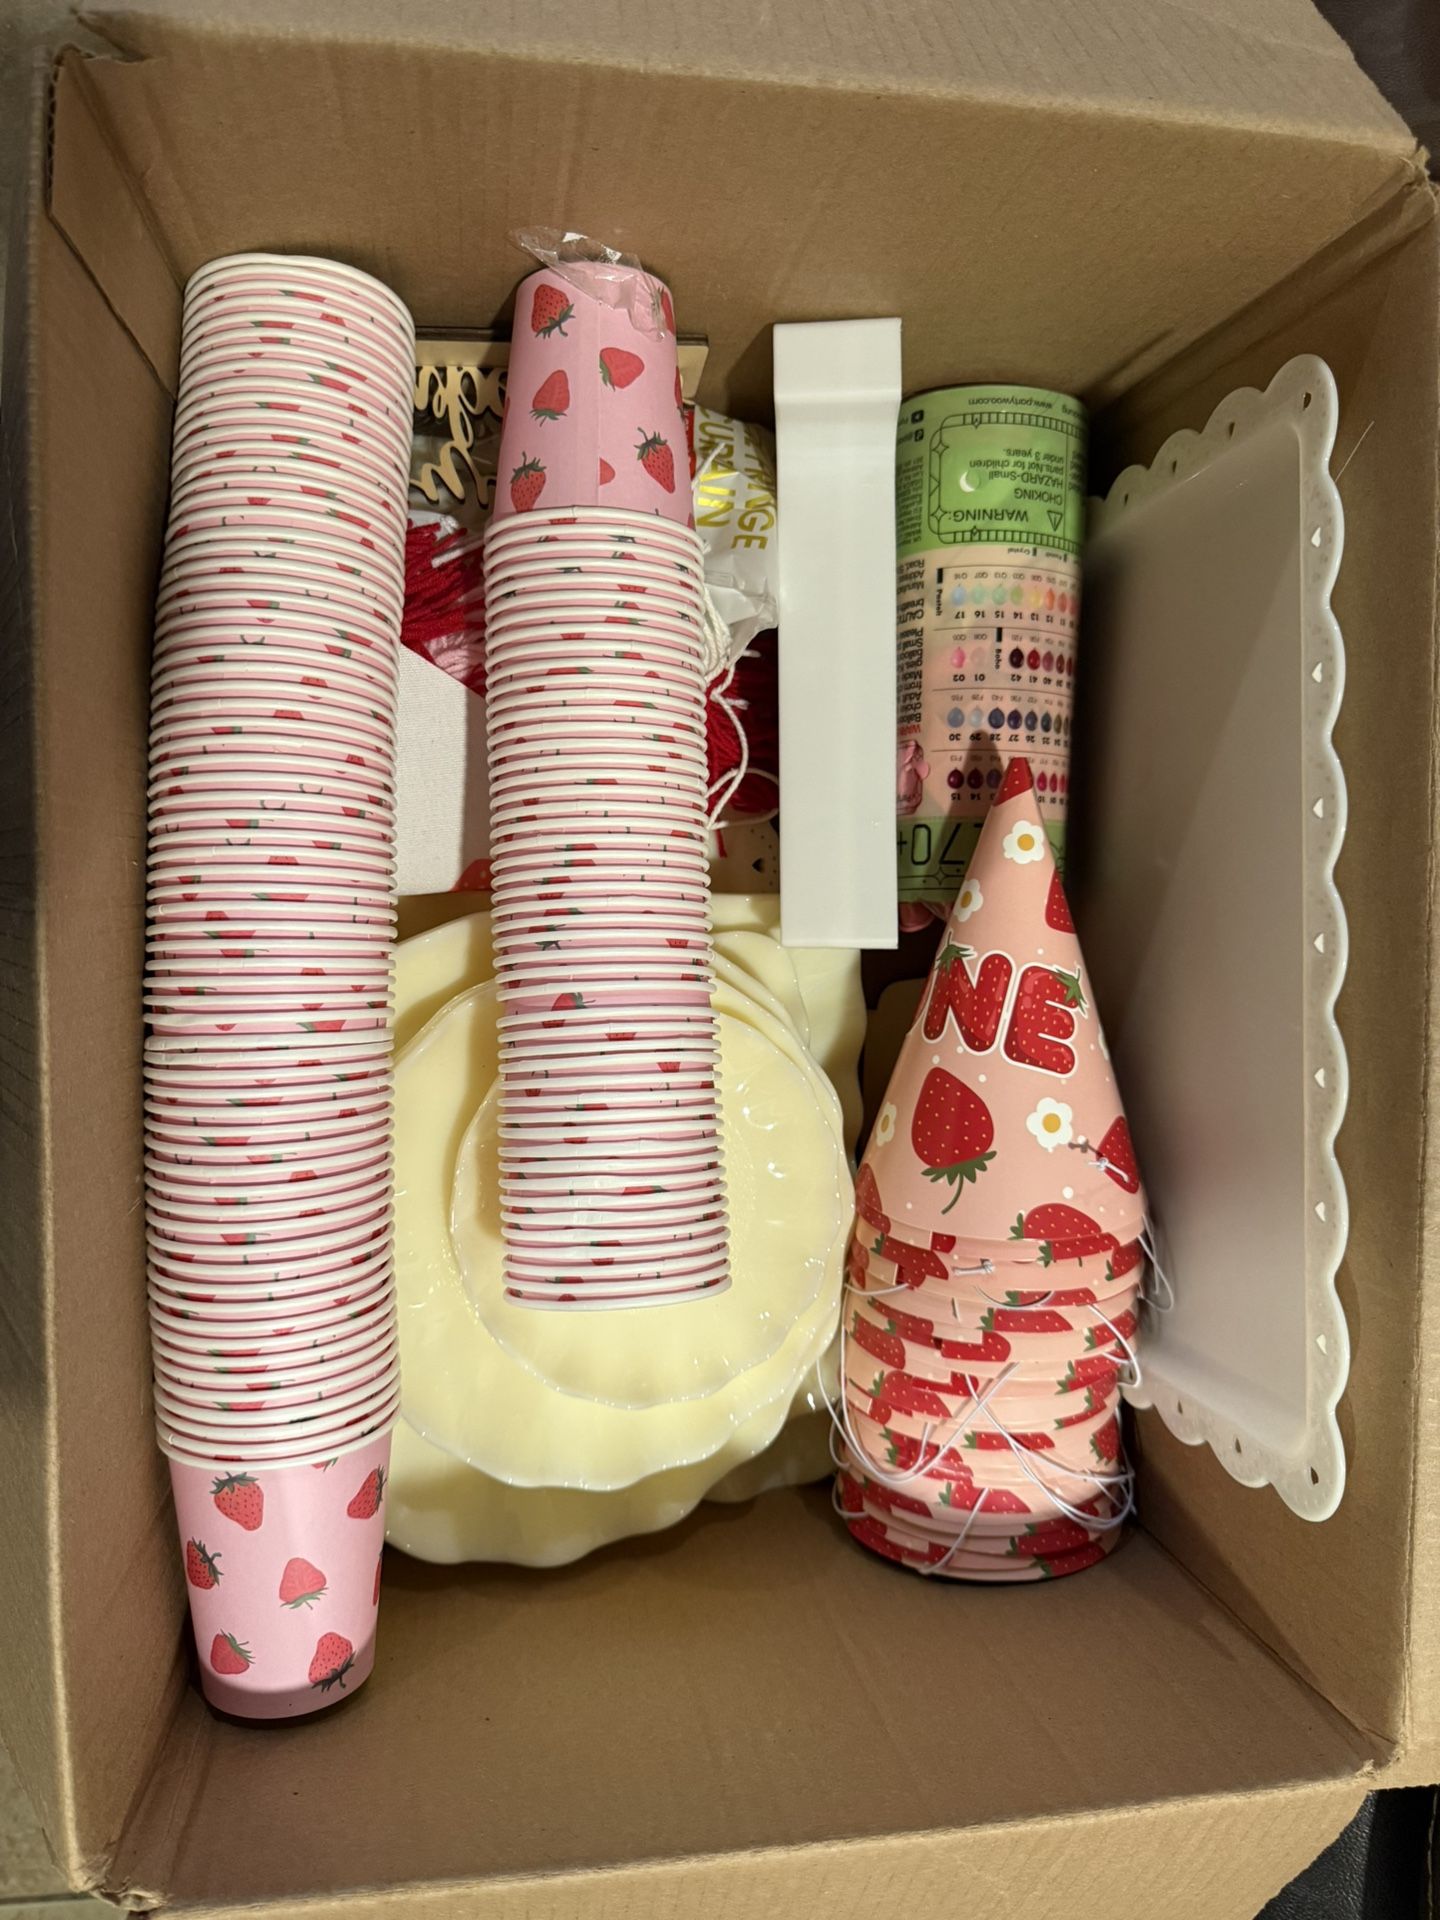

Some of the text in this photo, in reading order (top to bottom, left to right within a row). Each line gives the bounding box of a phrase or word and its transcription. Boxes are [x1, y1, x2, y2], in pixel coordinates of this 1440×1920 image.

[969, 396, 1052, 411] www.partywoo.com
[1003, 448, 1064, 464] under 3 years.
[696, 406, 736, 528] URAIN
[969, 459, 1009, 469] children
[1013, 461, 1025, 470] for
[989, 471, 1063, 489] HAZARD-Small
[1014, 488, 1063, 506] CHOKING
[948, 509, 1029, 523] WARNING:
[955, 611, 965, 620] 17
[974, 610, 985, 619] 16
[995, 610, 1004, 619] 15
[1013, 611, 1022, 620] 14
[1030, 613, 1039, 621] 13
[1046, 615, 1053, 623] 12
[953, 674, 965, 682] 02
[974, 674, 985, 682] 01
[1010, 674, 1021, 683] 42
[1029, 676, 1038, 684] 41
[1043, 677, 1052, 685] 40
[949, 733, 961, 742] 30
[970, 733, 982, 742] 29
[990, 733, 1001, 742] 28
[1008, 734, 1019, 742] 27
[1025, 735, 1035, 743] 26
[1042, 737, 1051, 745] 25
[951, 792, 961, 801] 15
[970, 792, 981, 801] 14
[897, 822, 982, 866] 70+
[907, 949, 1087, 1076] NE
